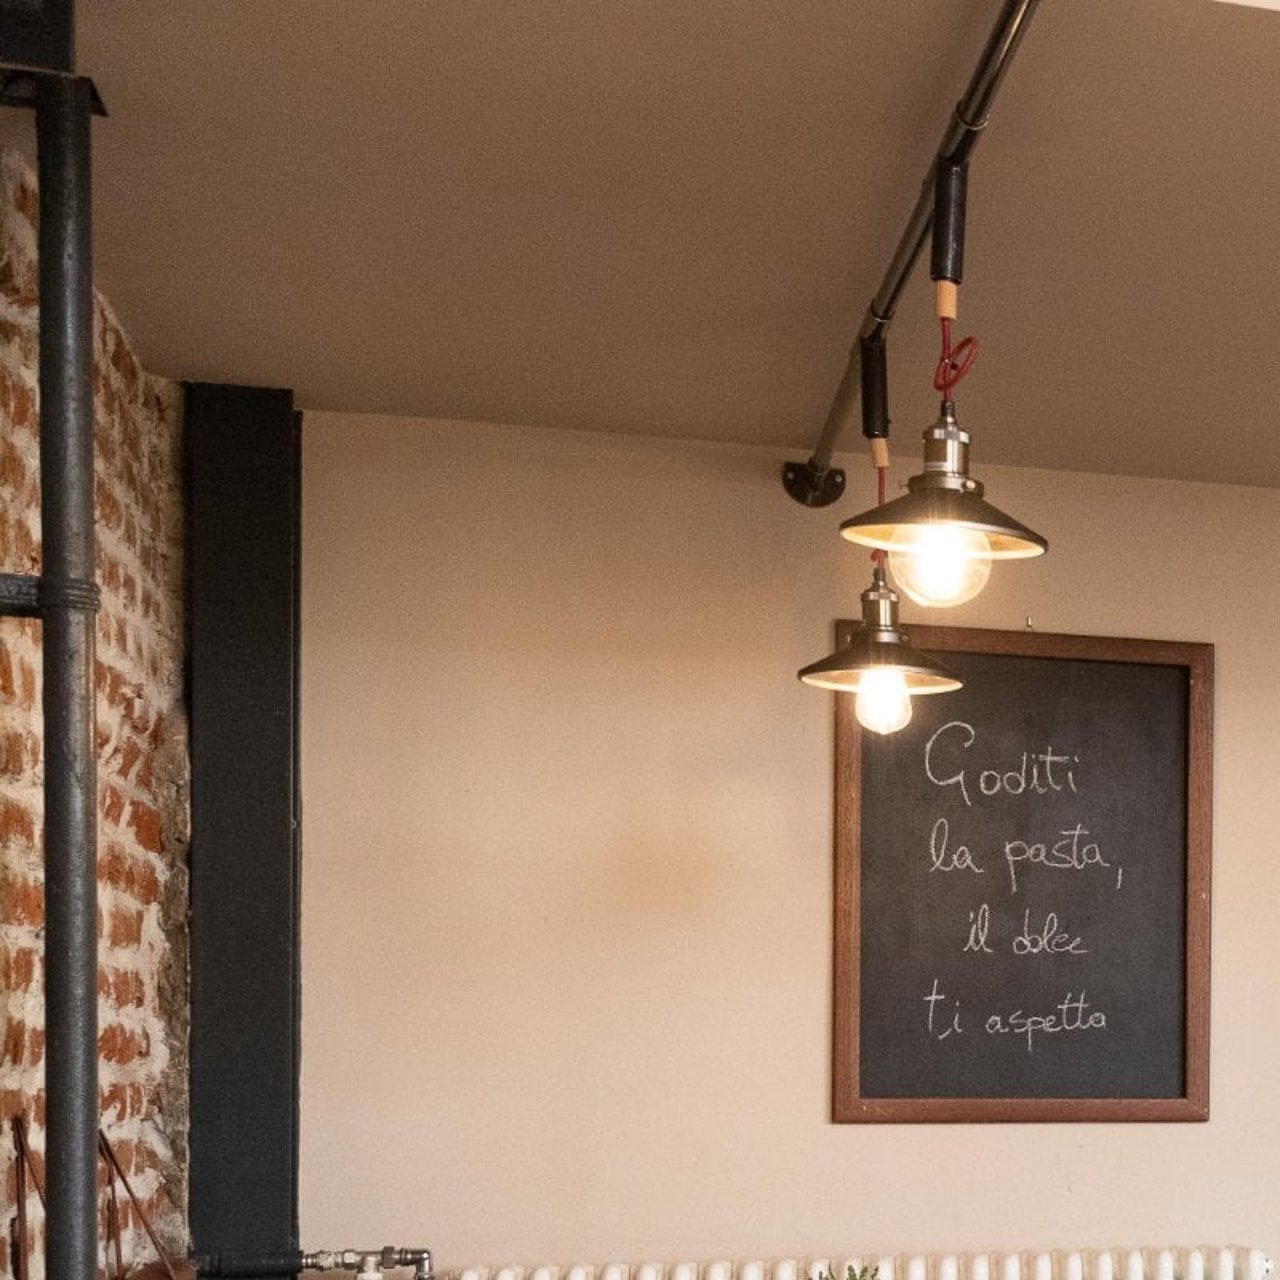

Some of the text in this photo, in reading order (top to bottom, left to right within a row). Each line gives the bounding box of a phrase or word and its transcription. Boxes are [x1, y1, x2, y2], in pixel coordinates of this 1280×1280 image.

[925, 720, 1081, 806] Goditi
[929, 817, 1124, 895] la pasta,
[963, 903, 1089, 955] il dolce
[923, 978, 963, 1040] ti
